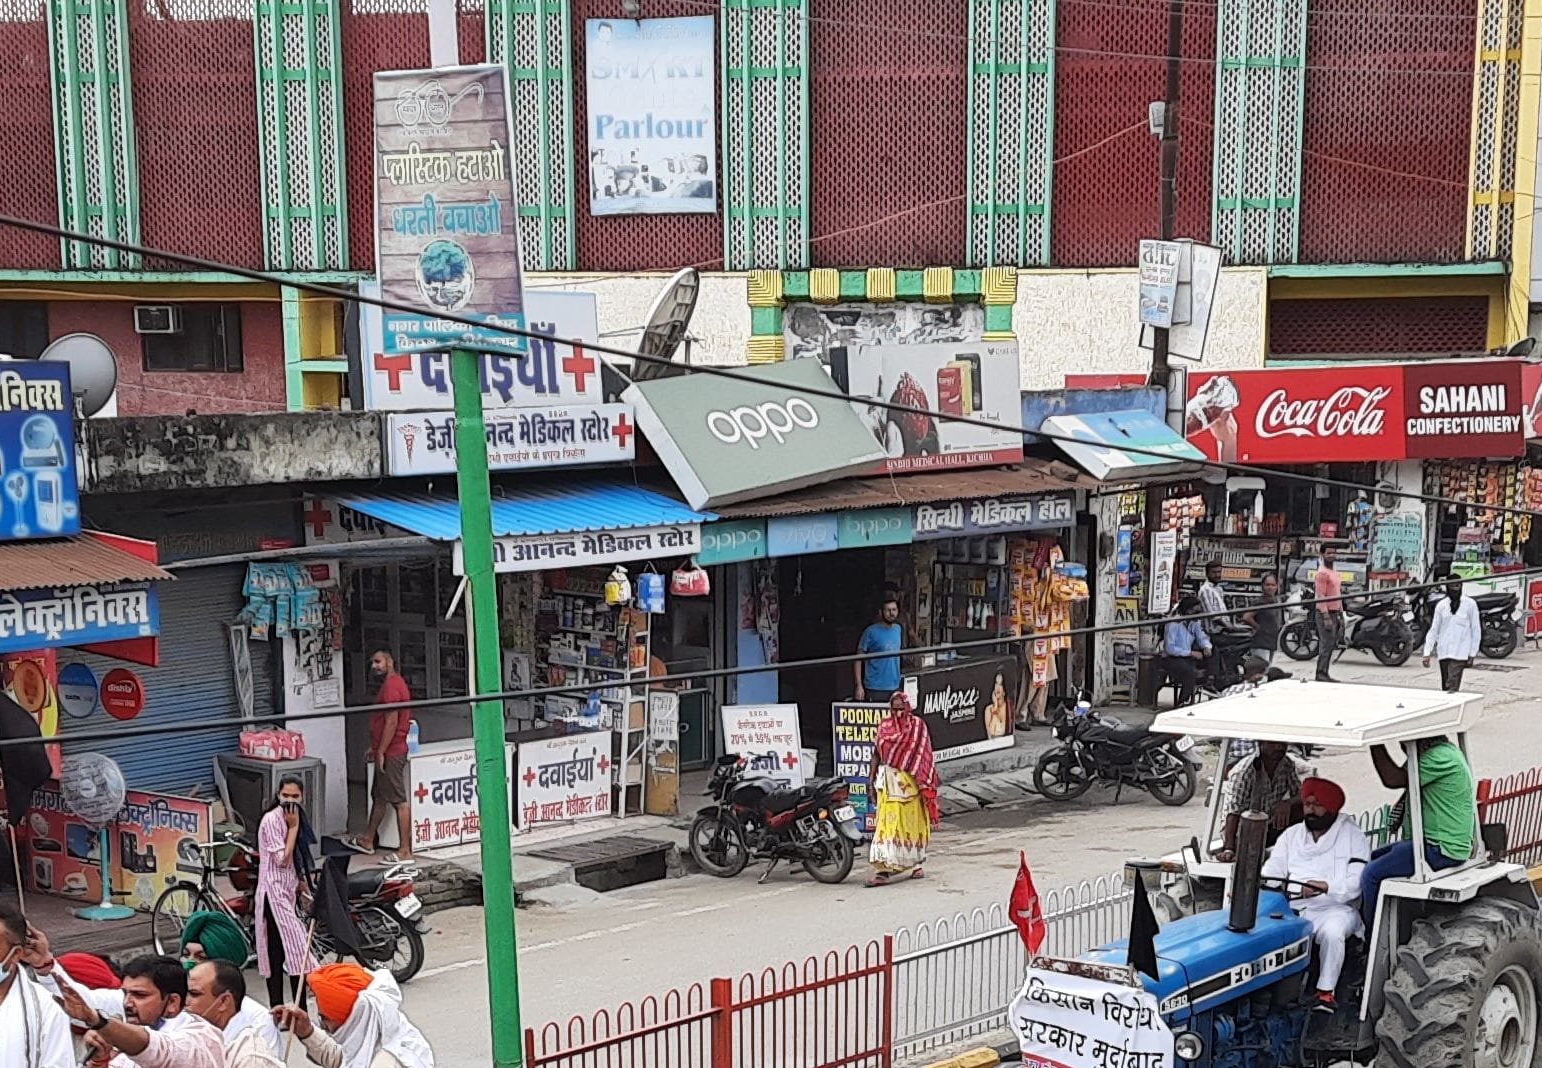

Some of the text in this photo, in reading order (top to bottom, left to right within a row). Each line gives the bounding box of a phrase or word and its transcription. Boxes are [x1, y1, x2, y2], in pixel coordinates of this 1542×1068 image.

[596, 112, 708, 140] Parlour
[382, 139, 506, 186] प्लास्टिक हटाओ
[392, 193, 439, 236] धरती
[1419, 384, 1506, 414] SAHANI
[518, 412, 576, 447] मेडिकल
[579, 409, 610, 442] स्टोर
[705, 394, 822, 451] oppo
[1406, 414, 1521, 437] CONFECTIONERY
[970, 499, 1032, 527] मेडिकल
[1038, 496, 1072, 522] हॉल
[512, 526, 694, 563] आनन्द मेडिकल स्टोर
[702, 528, 762, 553] oppo
[848, 516, 902, 541] oppo
[835, 724, 878, 742] TELEC
[837, 763, 871, 778] REPAI
[839, 744, 876, 762] MOB
[1025, 977, 1096, 1016] किसान
[1019, 1016, 1088, 1058] सरकार
